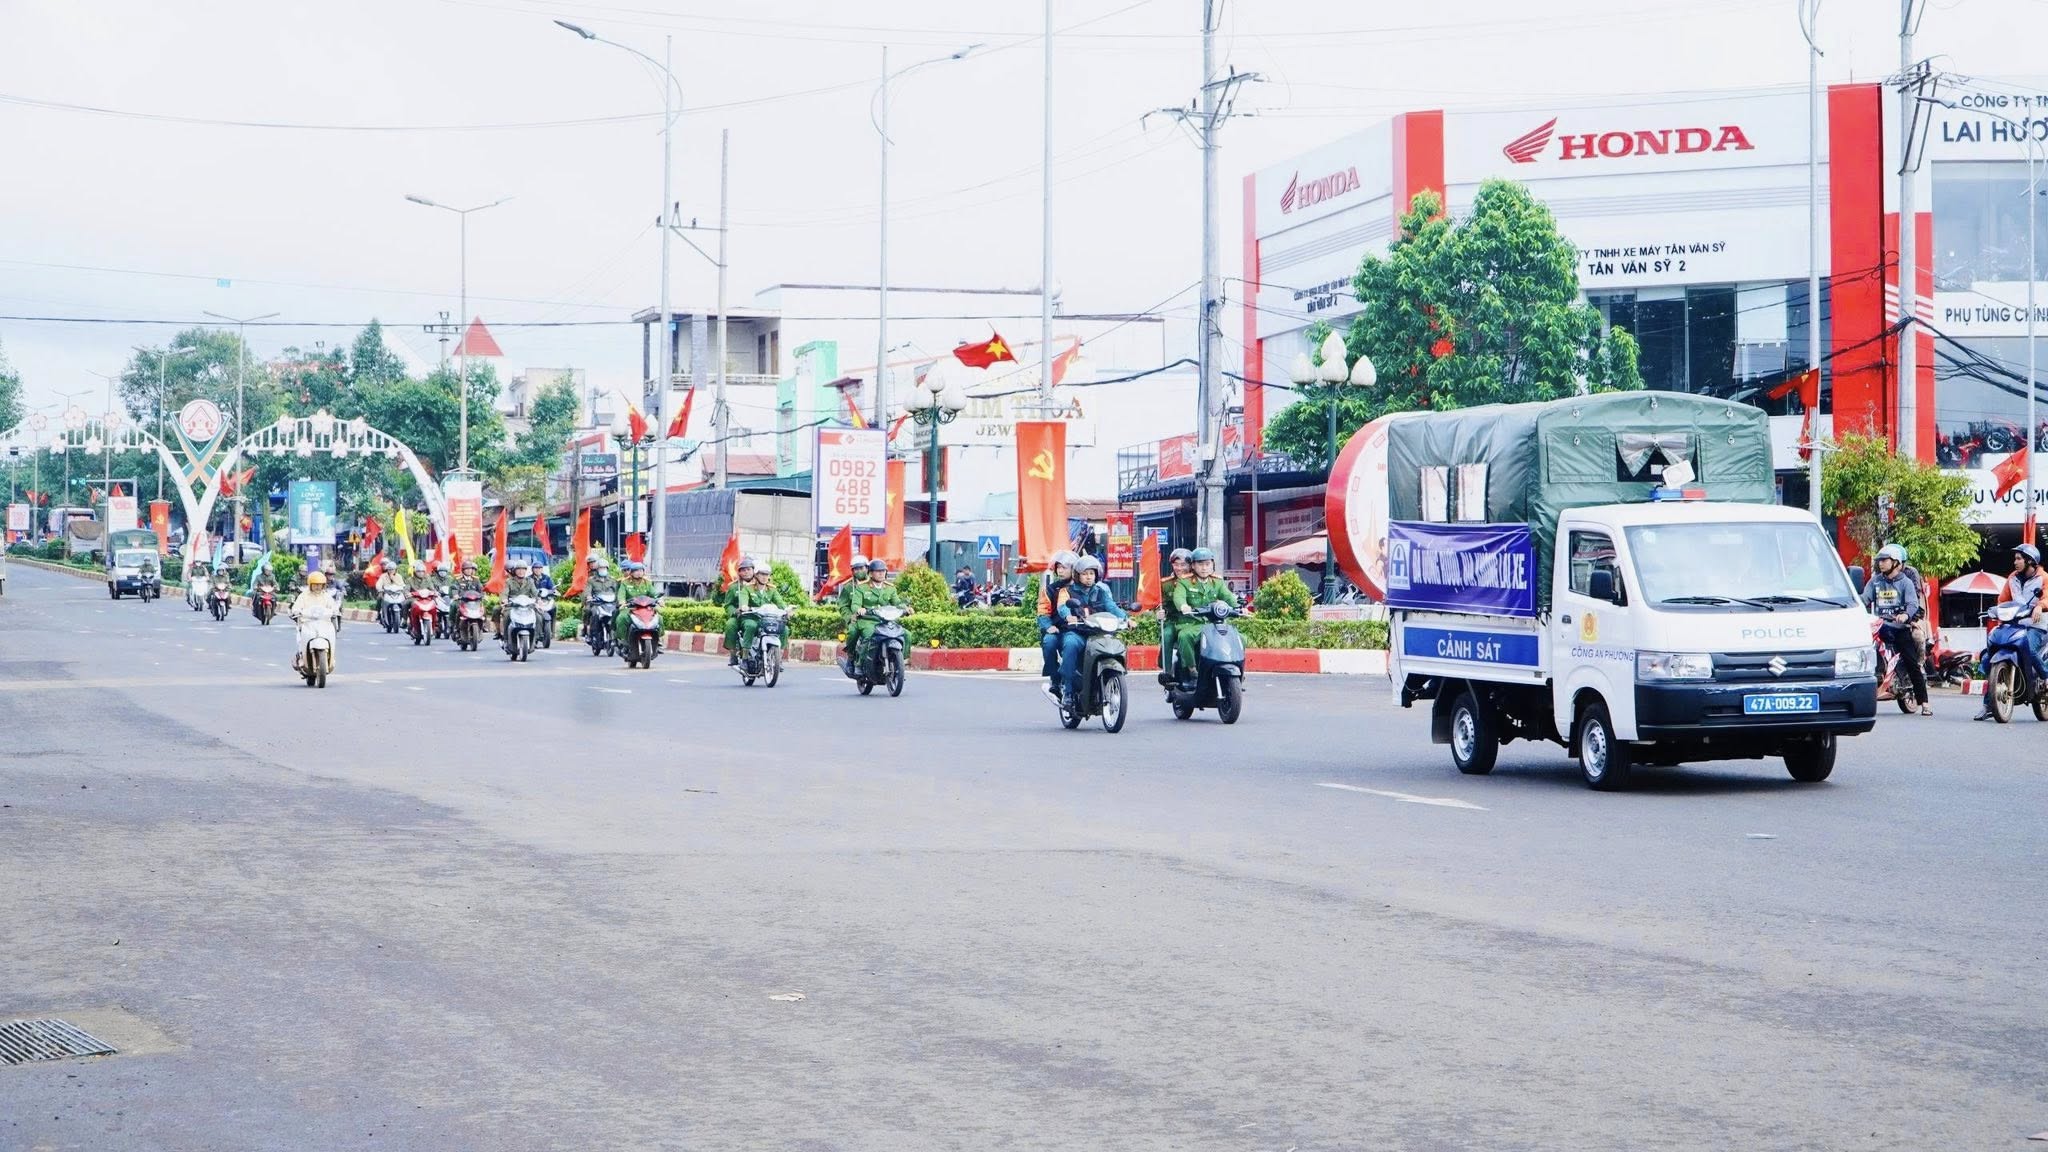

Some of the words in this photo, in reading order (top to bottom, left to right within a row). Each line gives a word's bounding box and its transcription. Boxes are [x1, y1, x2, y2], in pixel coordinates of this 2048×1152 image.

[1961, 92, 2009, 108] CÔNG
[1943, 121, 1981, 142] LAI
[1559, 126, 1755, 160] HONDA
[1298, 166, 1360, 210] HONDA
[1594, 249, 1621, 259] TNHH
[1624, 248, 1637, 257] XE
[1640, 244, 1661, 257] MÁY
[1666, 243, 1686, 255] TÂN
[1689, 242, 1709, 254] VĂN
[1588, 261, 1614, 276] TÂN
[1622, 260, 1647, 274] VĂN
[1654, 259, 1671, 273] SỸ
[1679, 260, 1686, 272] 2
[1945, 307, 1971, 326] PHỤ
[1975, 303, 2011, 323] TÙNG
[830, 460, 876, 478] 0982
[835, 479, 870, 496] 488
[835, 498, 870, 515] 655
[1742, 627, 1807, 640] POLICE
[1437, 633, 1472, 659] CẢNH
[1477, 636, 1502, 662] SÁT
[1571, 646, 1594, 658] CÔNG
[1594, 648, 1604, 659] AN
